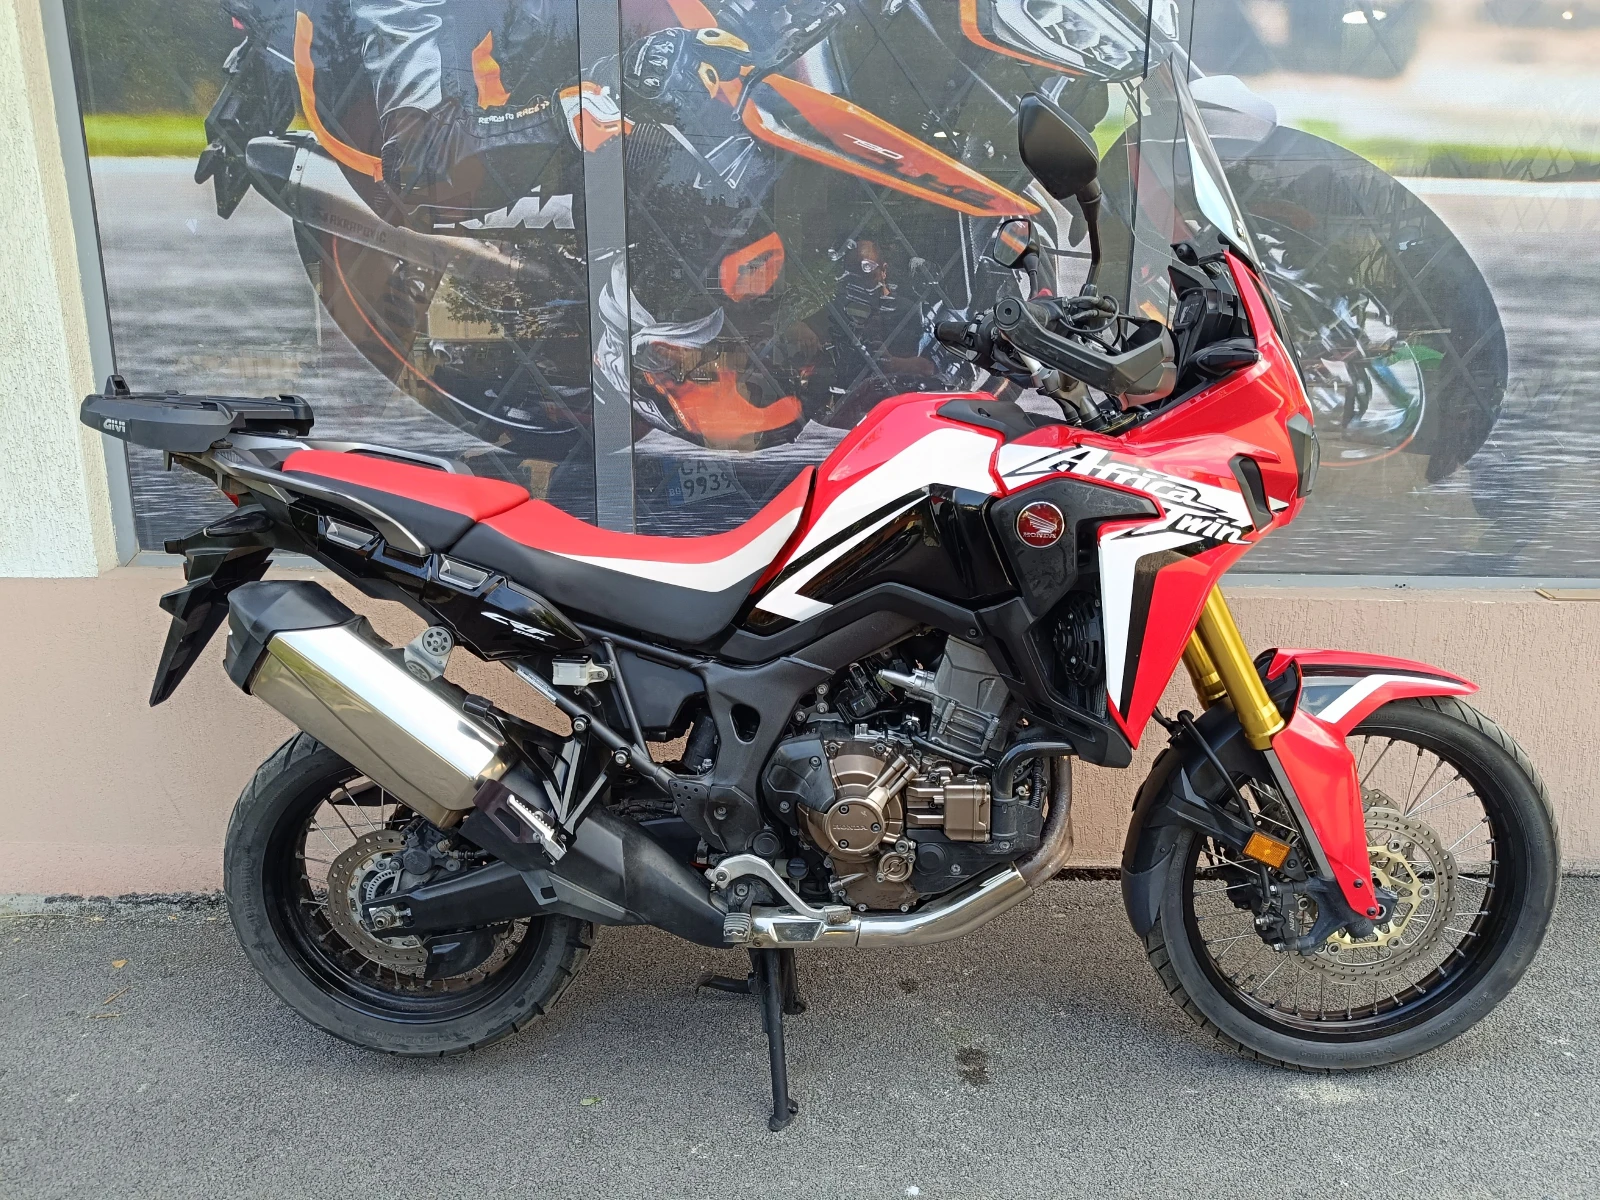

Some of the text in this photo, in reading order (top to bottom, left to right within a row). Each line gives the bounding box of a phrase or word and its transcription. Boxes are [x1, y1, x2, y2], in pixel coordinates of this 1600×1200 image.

[516, 104, 540, 119] RACE
[103, 418, 126, 433] GIVI
[1003, 444, 1204, 504] Africa
[1111, 505, 1253, 545] Twin
[1022, 531, 1057, 539] HONDA
